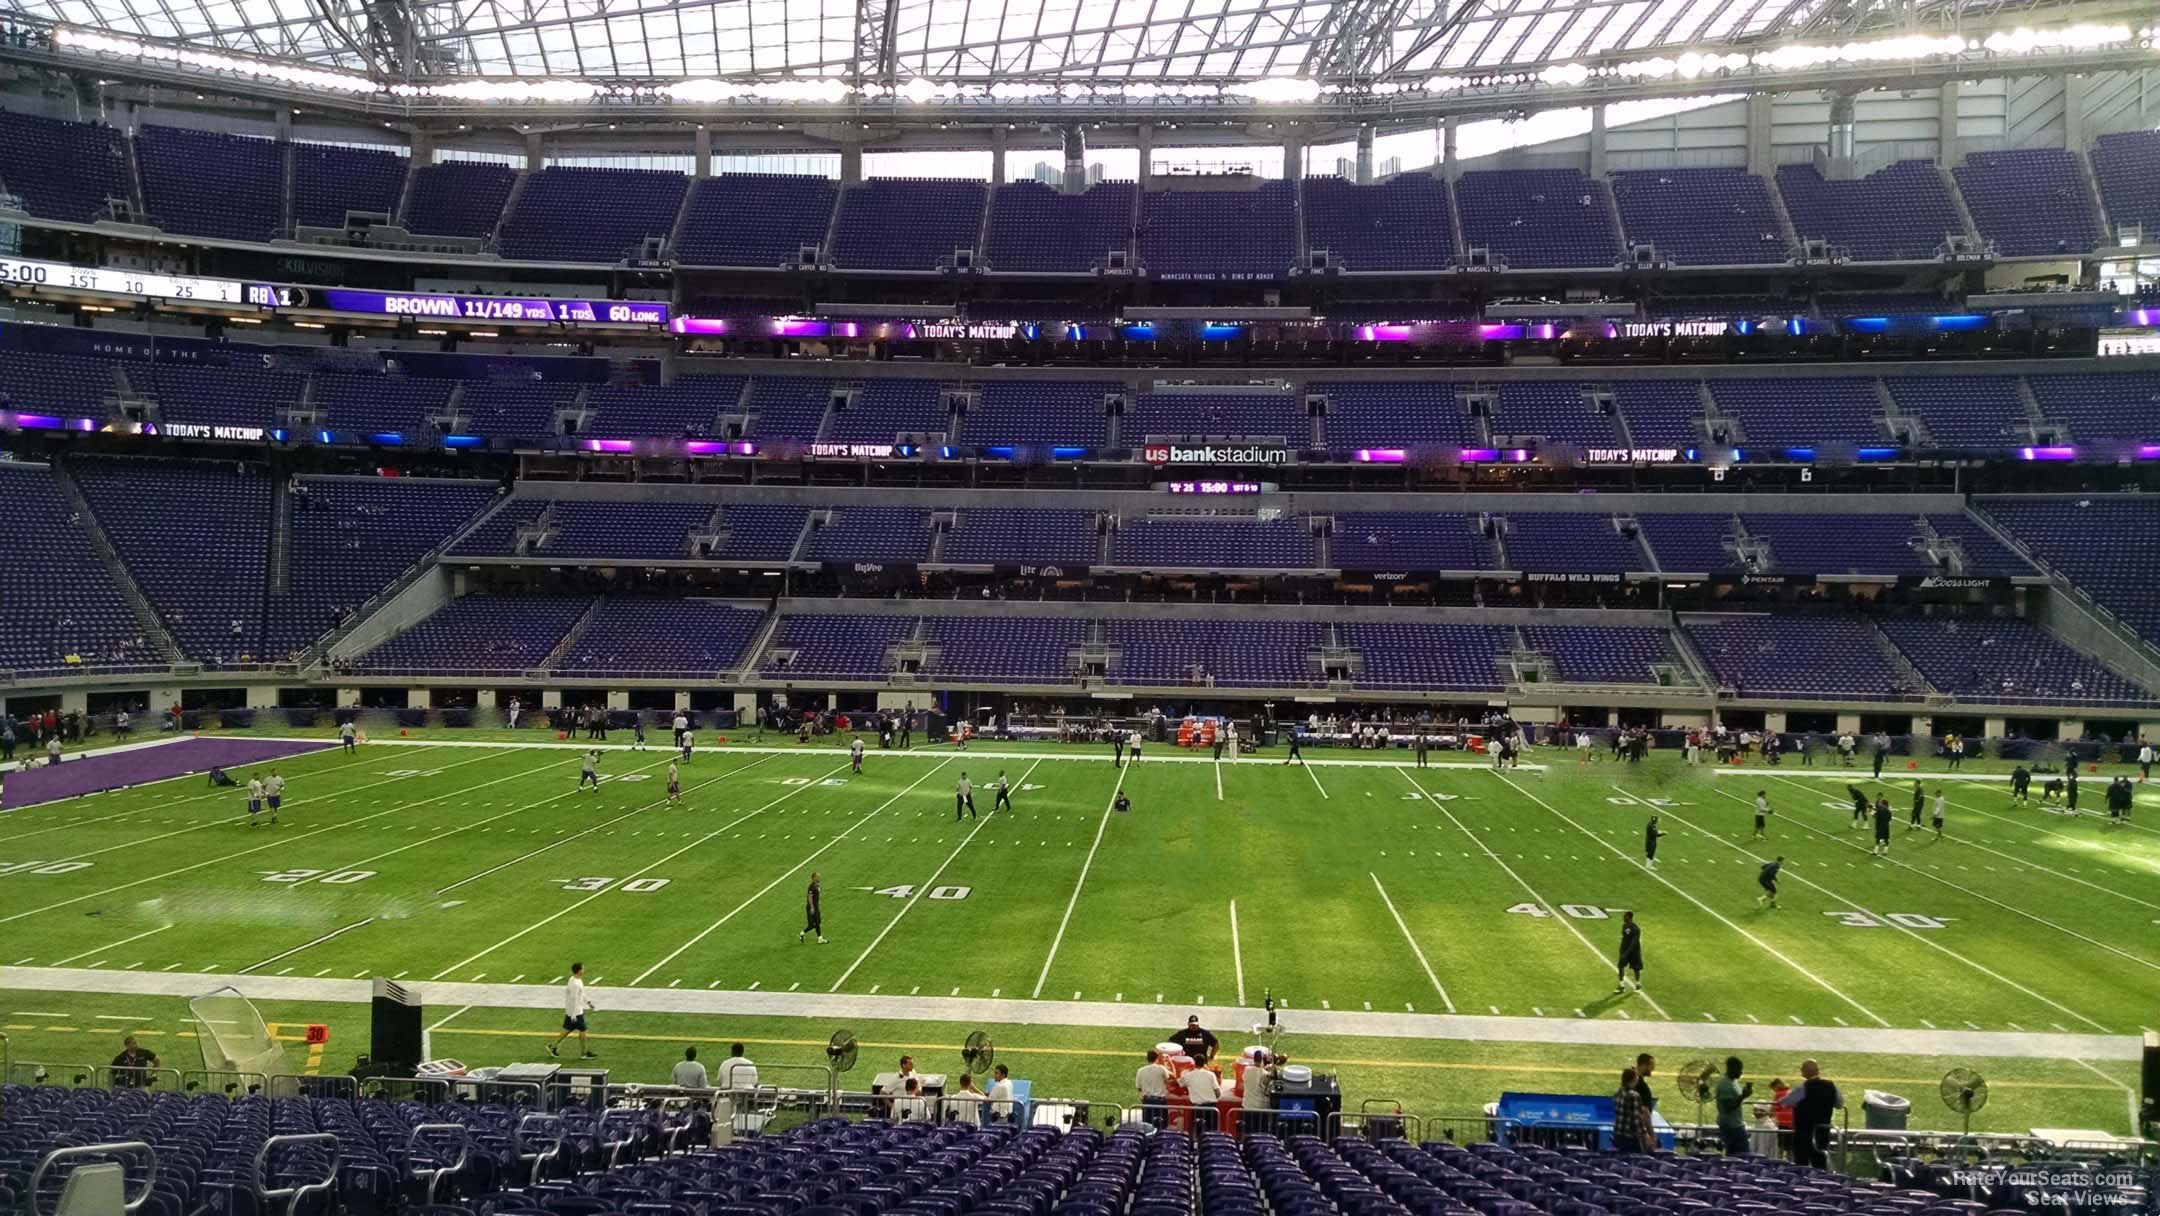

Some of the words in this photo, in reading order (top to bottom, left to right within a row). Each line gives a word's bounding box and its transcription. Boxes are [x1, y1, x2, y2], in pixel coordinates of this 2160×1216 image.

[69, 274, 99, 289] 1ST
[125, 280, 144, 293] 10
[176, 285, 193, 298] 25
[221, 289, 228, 300] 1
[250, 286, 268, 303] RB
[280, 290, 291, 306] 1
[385, 297, 453, 316] BROWN
[465, 301, 523, 319] 11/149
[525, 308, 546, 320] YDS
[559, 304, 569, 319] 1
[571, 309, 591, 320] TDS
[609, 306, 630, 321] 60
[631, 311, 659, 322] LONG
[923, 325, 965, 338] TODAY'S
[968, 326, 1016, 339] MATCHUP
[1625, 322, 1671, 336] TODAY'S
[1675, 321, 1728, 336] MATCHUP
[94, 344, 133, 354] HOME
[144, 348, 161, 356] OF
[172, 350, 198, 359] THE
[164, 423, 210, 437] TODAY'S
[214, 425, 263, 441] MATCHUP
[811, 444, 848, 456] TODAY'S
[851, 445, 893, 457] MATCHUP
[1589, 449, 1628, 461] TODAY'S
[1632, 449, 1677, 461] MATCHUP
[1200, 482, 1228, 493] 15:00
[1528, 573, 1567, 582] BUFFALO
[1568, 573, 1590, 583] WILD
[1592, 573, 1620, 583] WINGS
[261, 869, 378, 884] 20
[563, 876, 672, 893] 30
[872, 883, 973, 901] 40
[1506, 903, 1609, 919] 40
[1823, 911, 1946, 928] 30
[308, 1026, 324, 1041] 30
